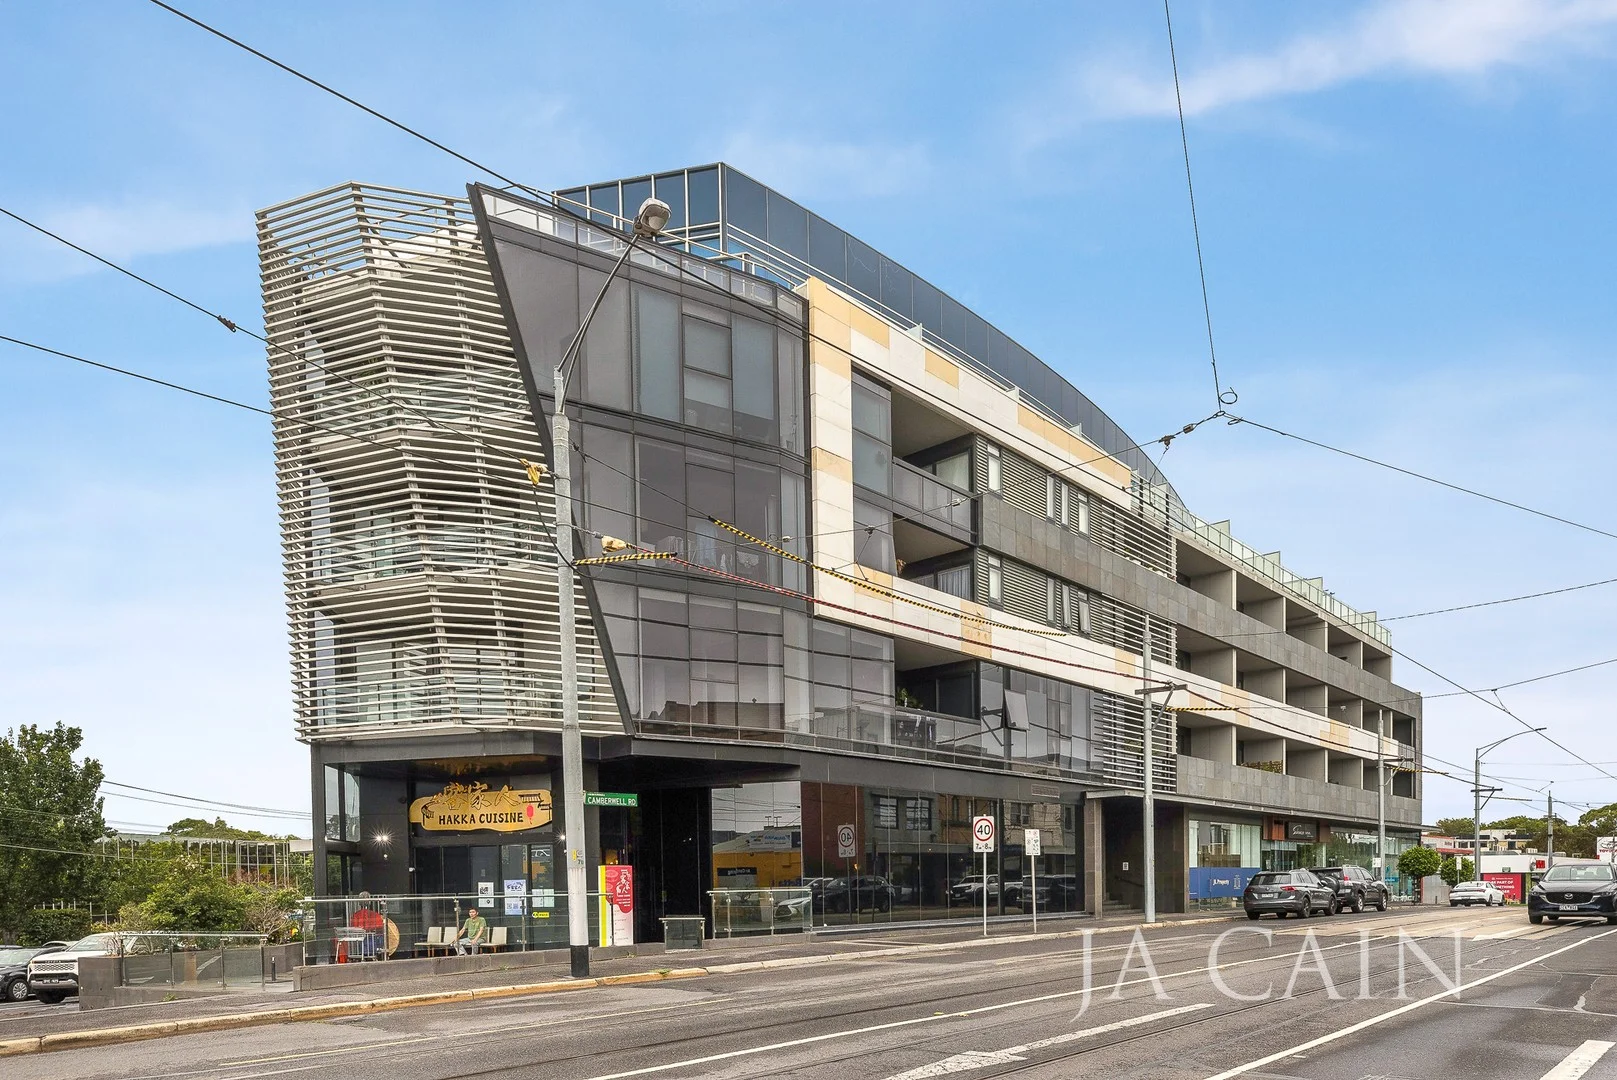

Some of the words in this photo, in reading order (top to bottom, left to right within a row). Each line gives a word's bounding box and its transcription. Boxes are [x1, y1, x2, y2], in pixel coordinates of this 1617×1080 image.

[587, 796, 626, 806] CAMBERWELL
[628, 798, 636, 806] RD
[438, 814, 476, 825] HAKKA
[479, 812, 524, 824] CUISINE
[976, 824, 991, 836] 40
